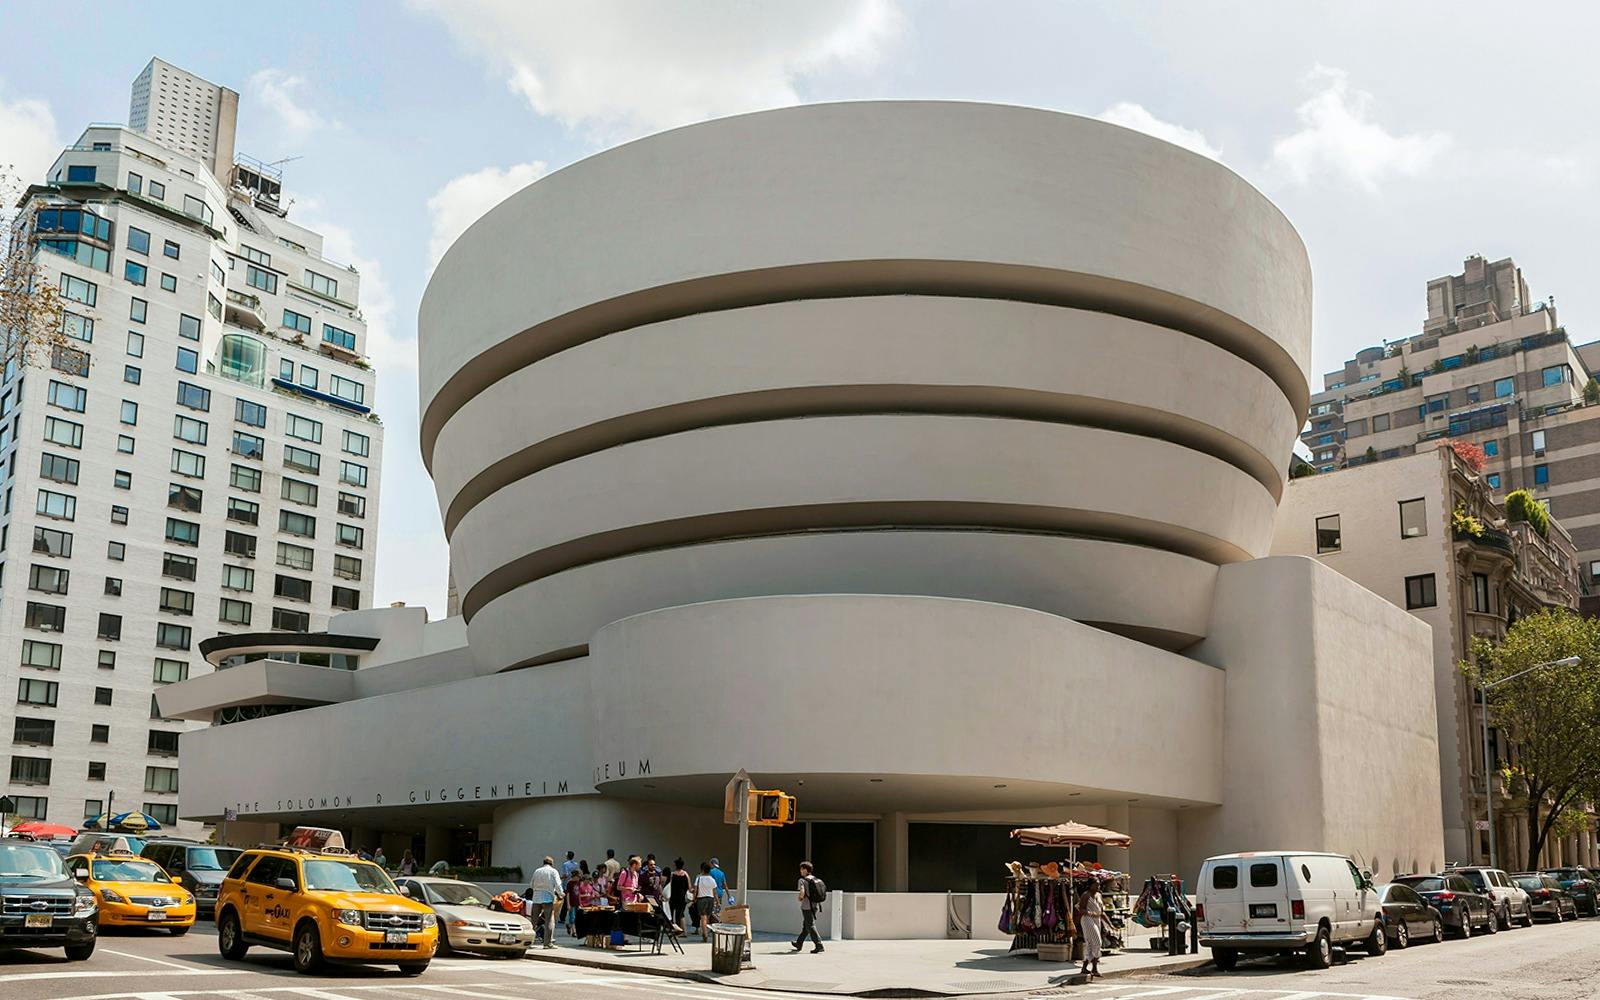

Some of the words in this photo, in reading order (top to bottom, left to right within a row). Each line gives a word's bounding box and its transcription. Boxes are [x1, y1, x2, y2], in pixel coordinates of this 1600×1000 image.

[237, 802, 259, 813] THE
[277, 796, 352, 811] SOLOMON
[376, 793, 383, 805] R
[409, 780, 569, 803] GUGGENHEIM
